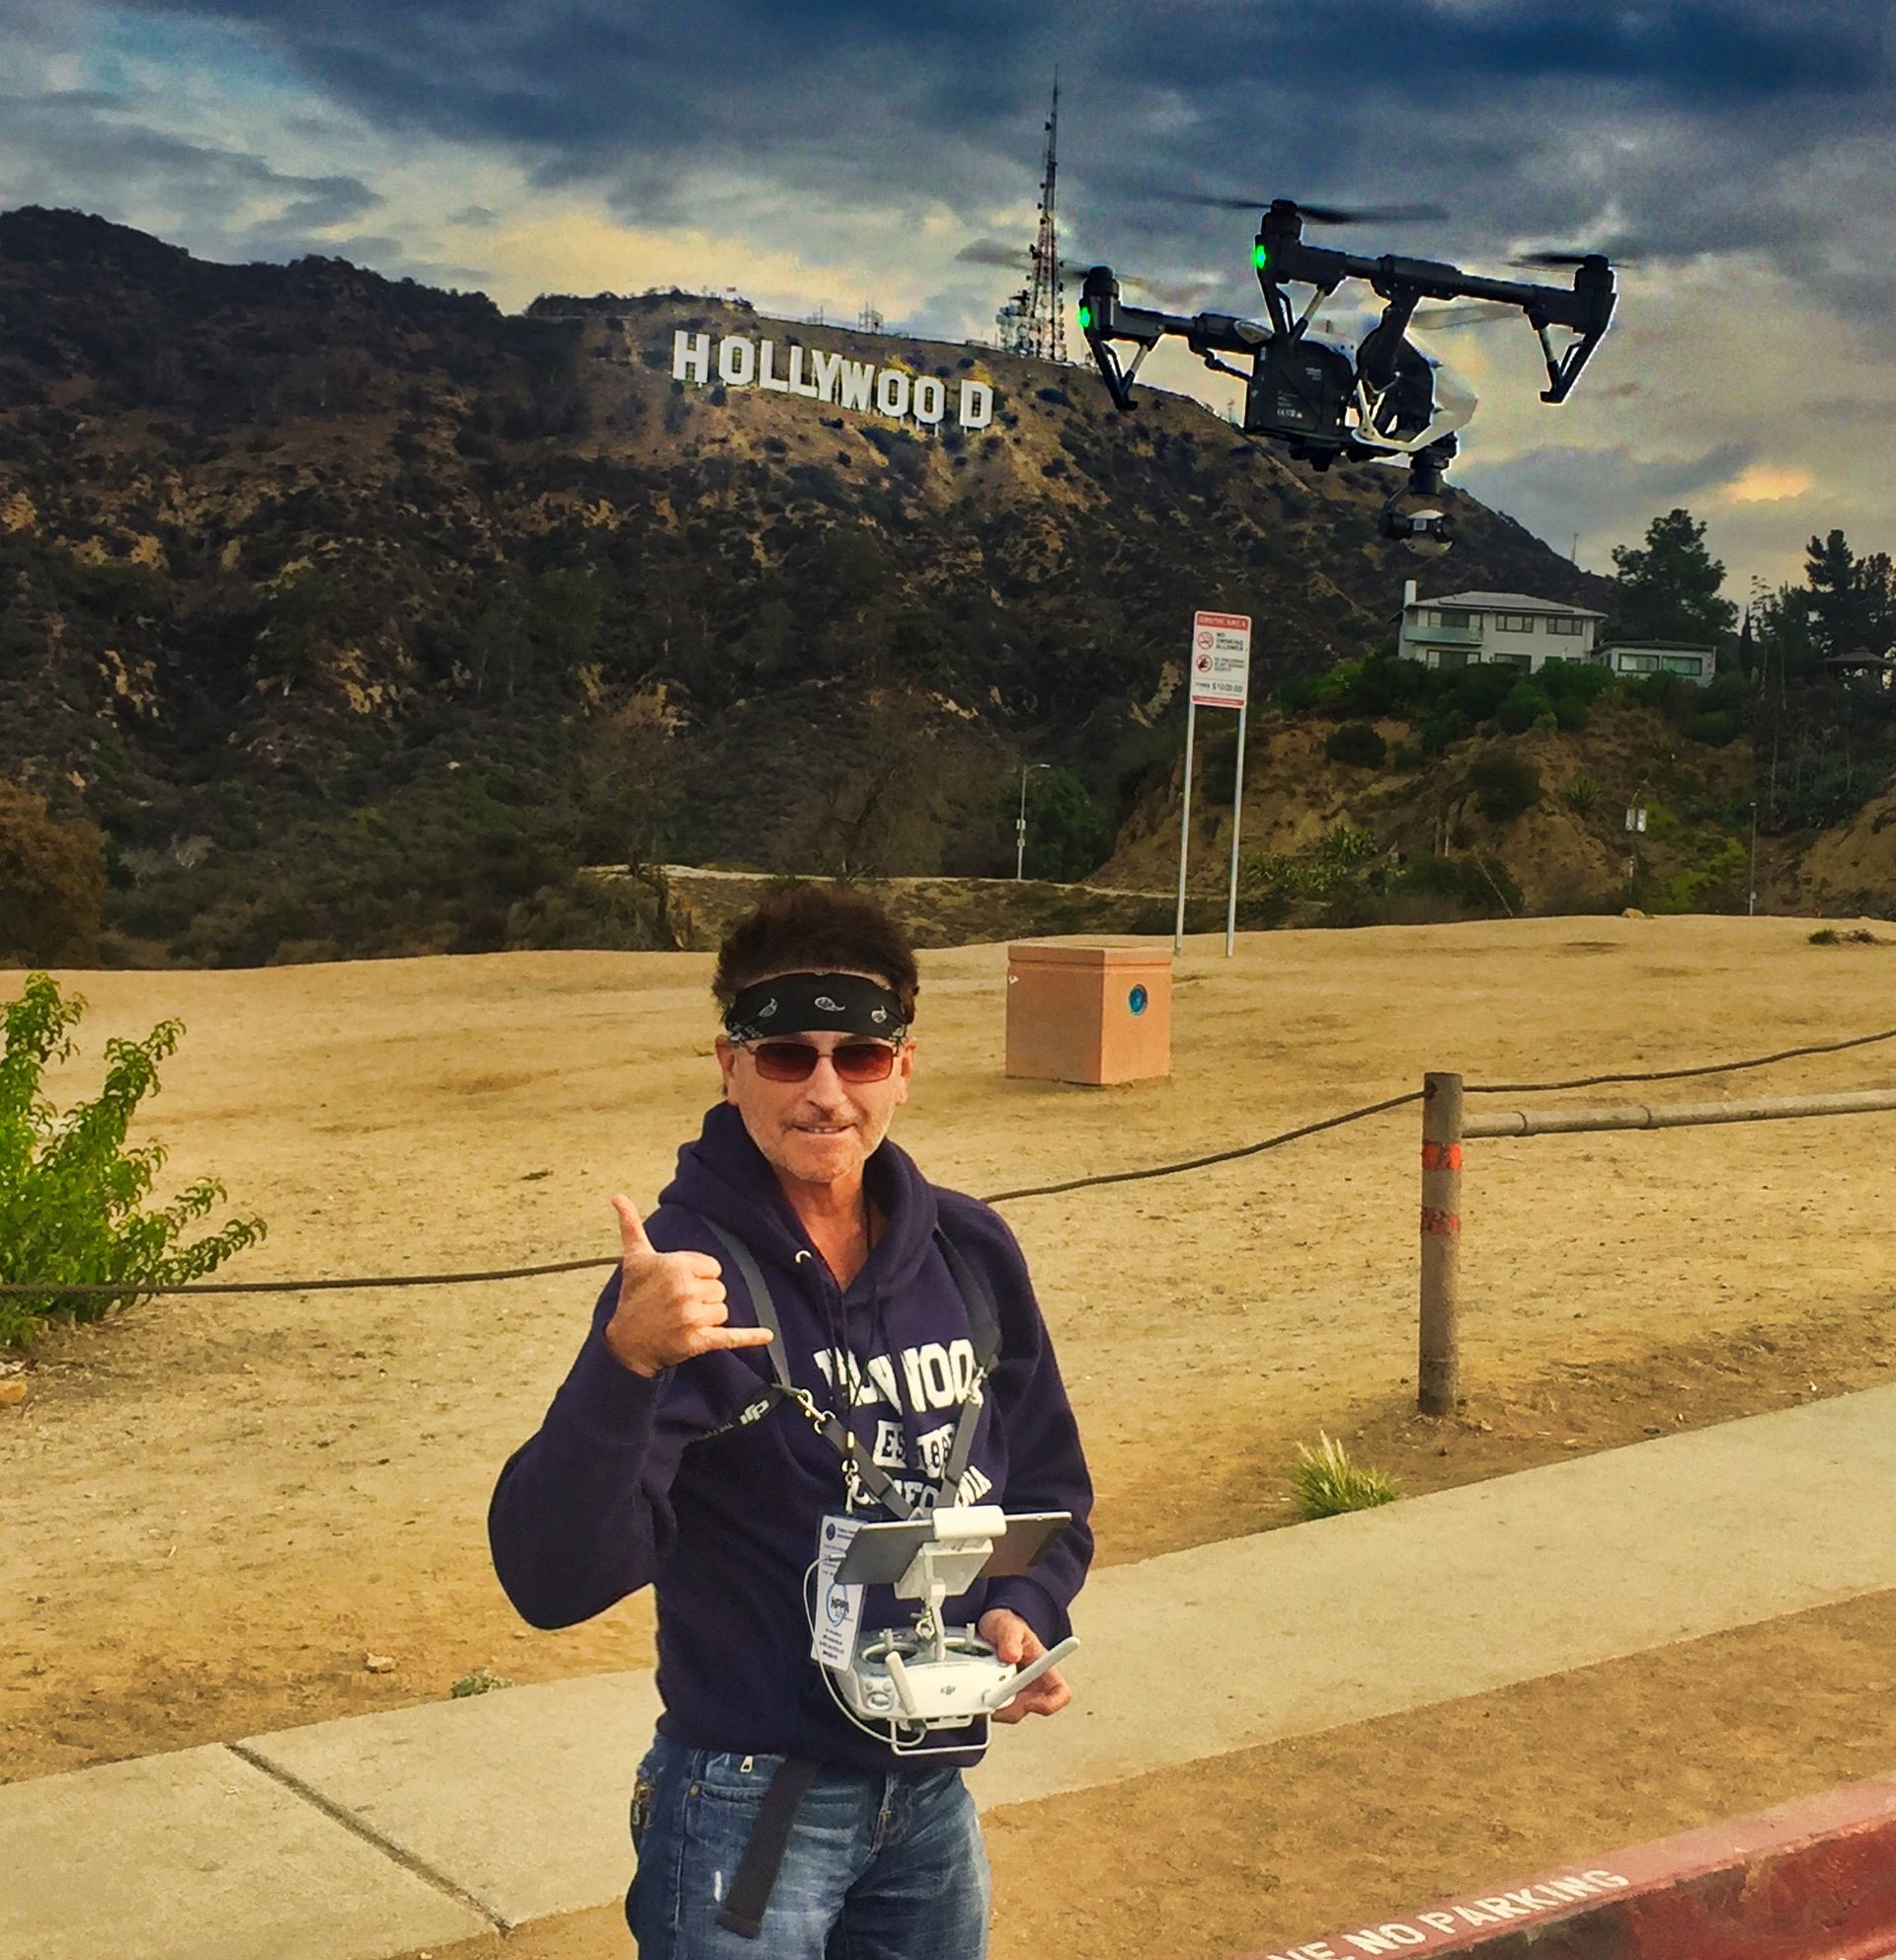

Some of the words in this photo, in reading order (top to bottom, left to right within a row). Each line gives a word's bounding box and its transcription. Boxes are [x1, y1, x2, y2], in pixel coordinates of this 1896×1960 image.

[672, 330, 993, 429] HOLLYWOOD
[1341, 1922, 1427, 1955] NO
[1416, 1869, 1630, 1934] PARKING
